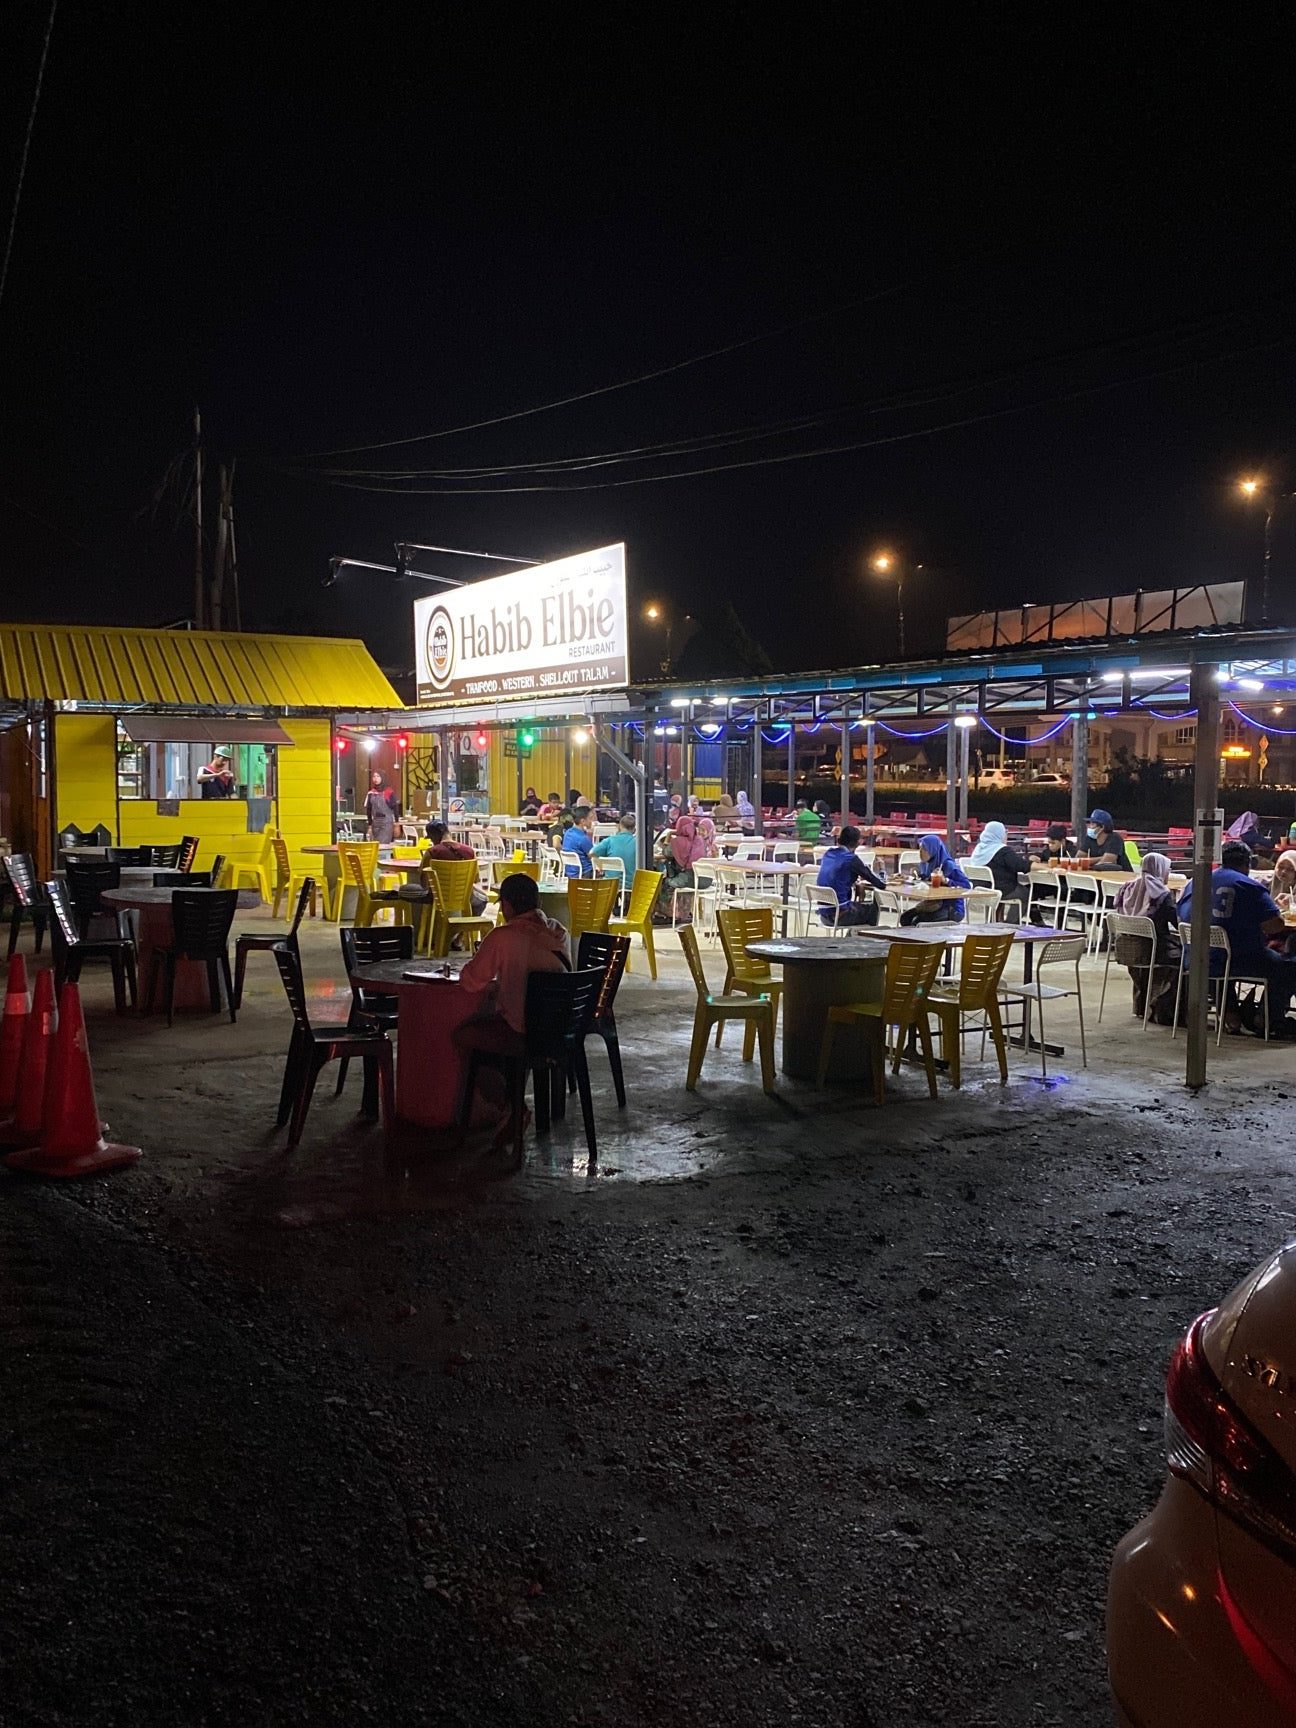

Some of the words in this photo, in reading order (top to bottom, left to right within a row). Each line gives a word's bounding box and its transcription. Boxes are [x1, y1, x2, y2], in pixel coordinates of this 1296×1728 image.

[459, 600, 533, 660] Habib
[541, 588, 615, 647] Elbie
[568, 641, 615, 658] RESTAURANT
[502, 675, 535, 691] WESTERN
[539, 669, 579, 687] SHELLOUT
[580, 665, 609, 682] TALAM
